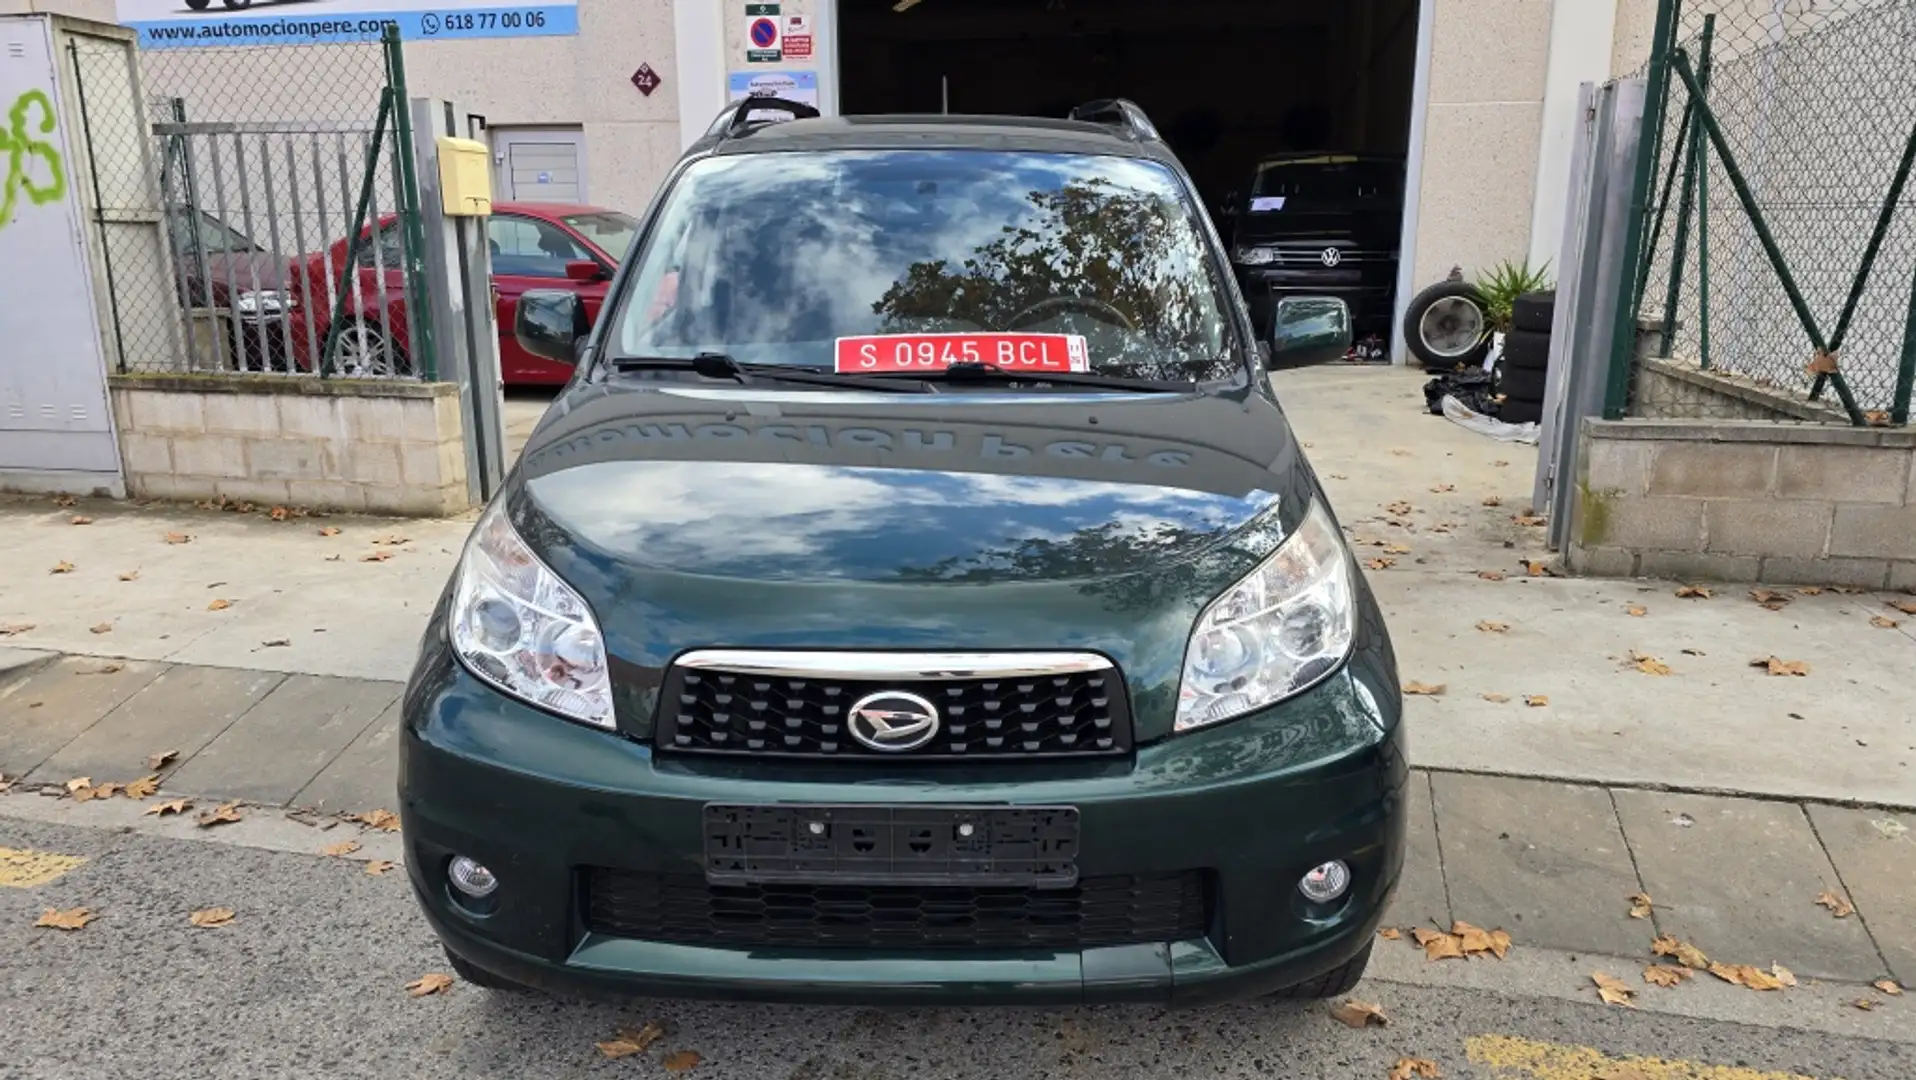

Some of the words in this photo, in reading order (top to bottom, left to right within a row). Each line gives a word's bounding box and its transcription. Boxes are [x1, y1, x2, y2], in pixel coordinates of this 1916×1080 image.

[148, 19, 397, 40] www.automocionpere.com
[445, 14, 473, 30] 618
[477, 13, 496, 29] 77
[501, 12, 521, 28] 00
[525, 11, 545, 27] 06
[638, 74, 652, 87] 24
[860, 344, 877, 367] S
[895, 342, 980, 367] 0945
[997, 341, 1059, 366] BCL
